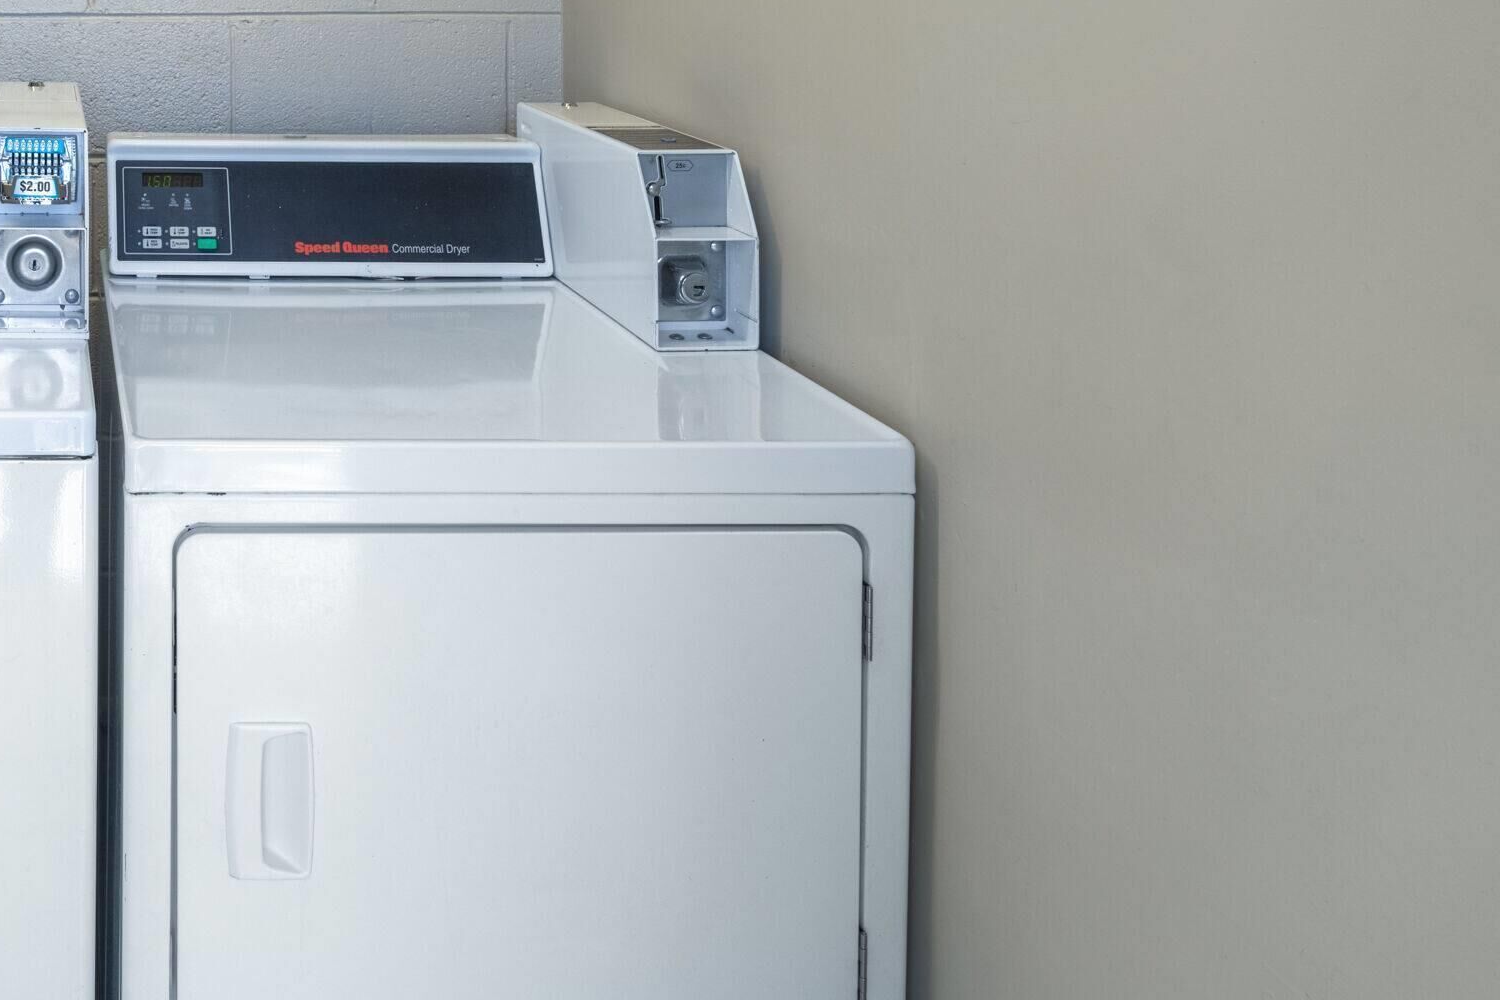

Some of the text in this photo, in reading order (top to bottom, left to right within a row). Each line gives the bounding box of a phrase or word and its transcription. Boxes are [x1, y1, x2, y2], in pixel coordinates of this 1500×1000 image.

[20, 181, 50, 192] $2.00
[294, 242, 470, 256] Speed Queen Commercial Dryer
